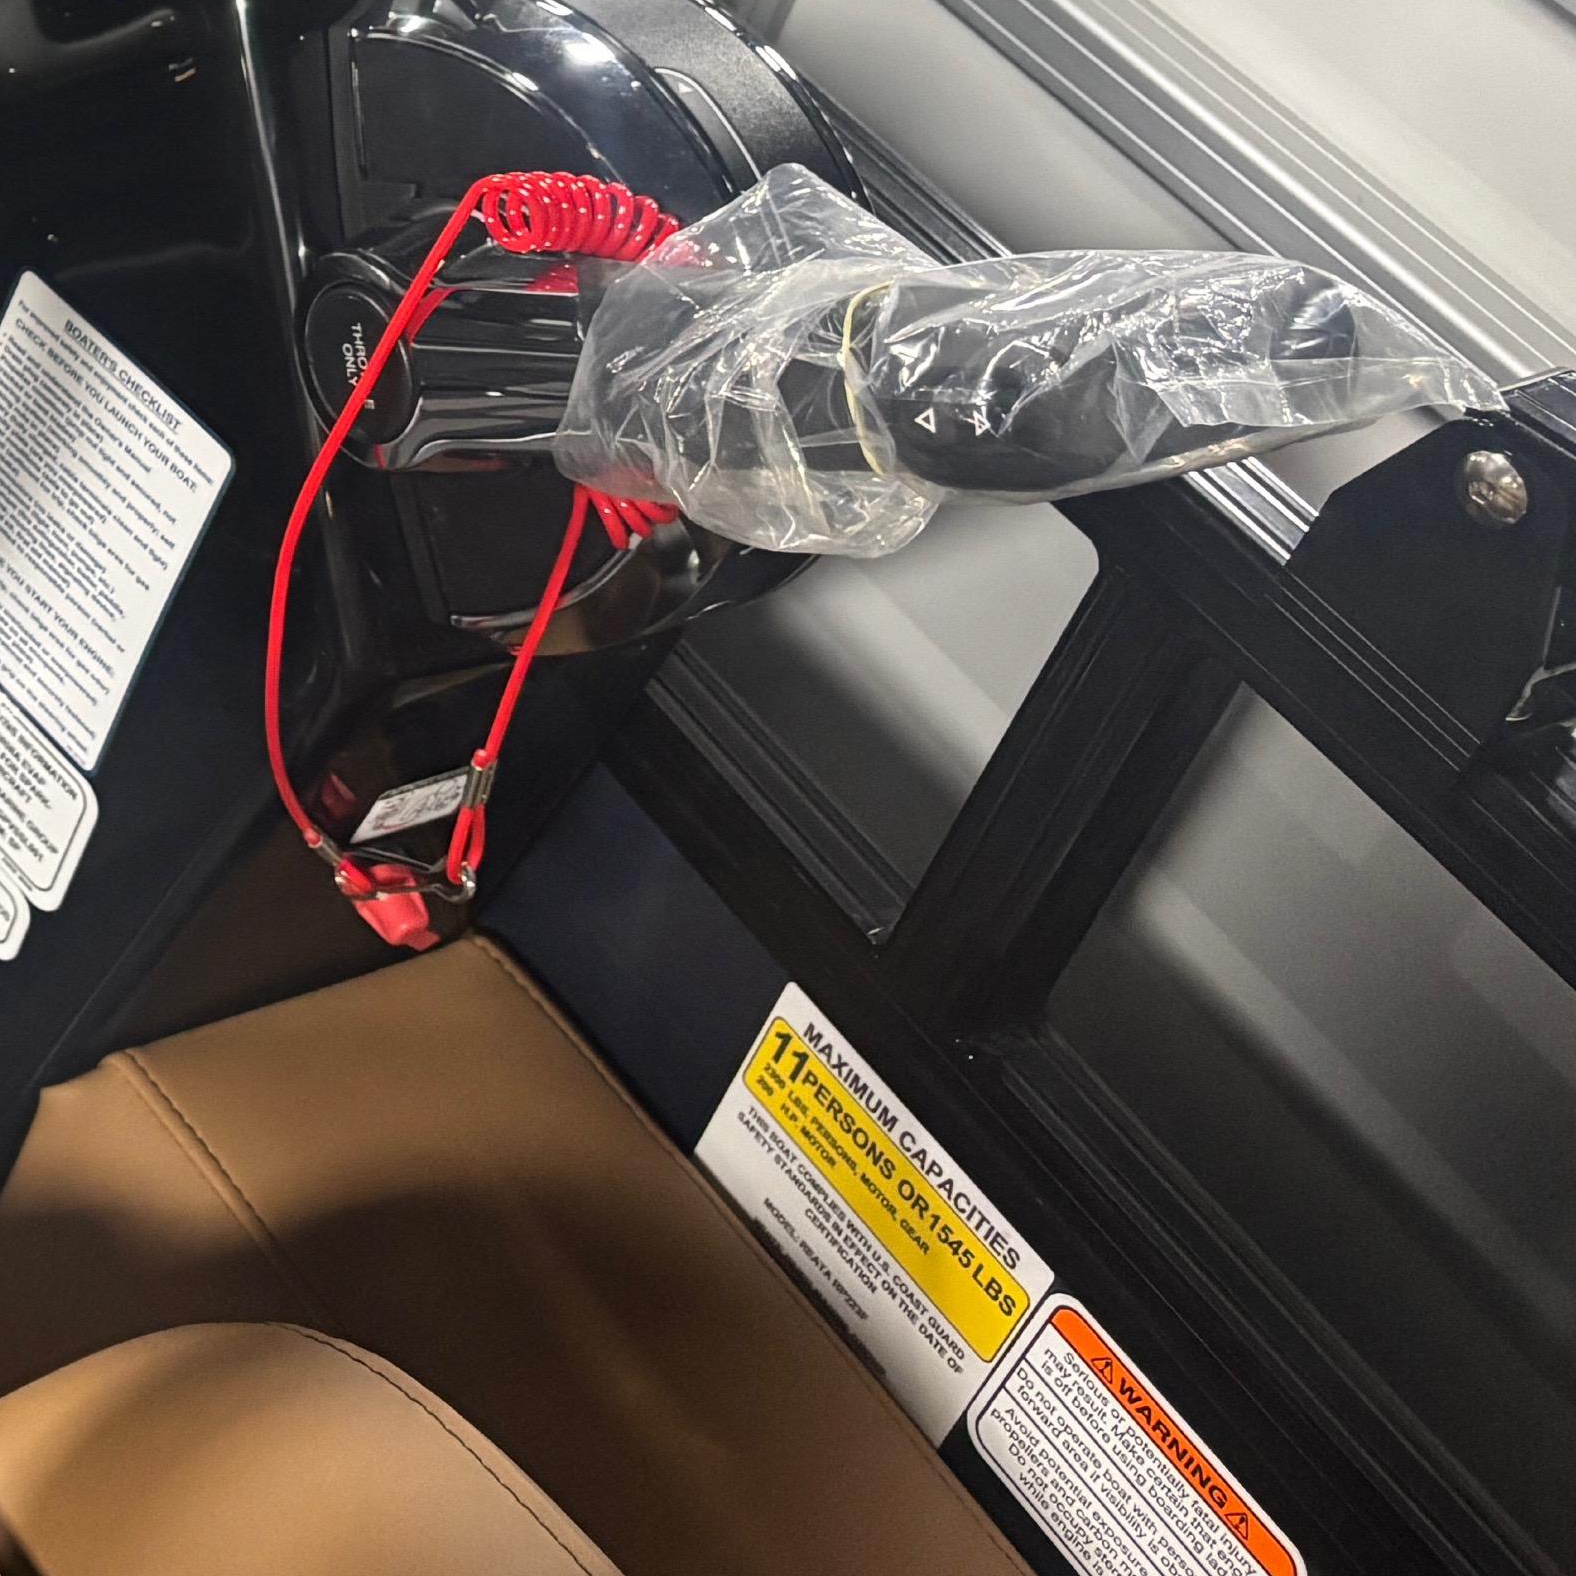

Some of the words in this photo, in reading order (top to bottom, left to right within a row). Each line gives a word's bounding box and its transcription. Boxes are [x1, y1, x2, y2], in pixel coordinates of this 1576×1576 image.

[15, 318, 47, 351] CHECK
[46, 347, 83, 384] BEFORE
[84, 380, 104, 404] YOU
[103, 399, 142, 440] LAUNCH
[143, 436, 169, 466] YOUR
[169, 462, 197, 492] BOAT:
[63, 318, 116, 372] BOATER'S
[115, 369, 181, 434] CHECKLIST
[342, 343, 360, 387] ONLY
[351, 322, 376, 410] THROE
[5, 563, 25, 586] YOU
[24, 583, 53, 613] START
[53, 611, 78, 640] YOUR
[772, 1031, 809, 1083] 11
[802, 1070, 895, 1179] PERSONS
[897, 1178, 929, 1220] OR
[928, 1213, 974, 1268] 1545
[971, 1263, 1016, 1316] LBS
[799, 1125, 836, 1168] MOTOR
[803, 1023, 897, 1131] MAXIMUM
[899, 1131, 1019, 1269] CAPACITIES
[737, 1111, 775, 1153] SAFETY
[774, 1153, 831, 1223] STANDARDS
[830, 1220, 843, 1237] IN
[842, 1234, 881, 1279] EFFECT
[880, 1279, 898, 1300] ON
[898, 1297, 919, 1325] THE
[918, 1322, 947, 1358] DATE
[946, 1356, 963, 1373] OF
[748, 1105, 769, 1133] THIS
[768, 1130, 797, 1163] BOAT
[797, 1163, 846, 1222] COMPLIES
[845, 1218, 872, 1252] WITH
[892, 1274, 928, 1315] COAST
[927, 1315, 964, 1360] GUARD
[804, 1208, 877, 1293] CERTIFICATION
[899, 1218, 930, 1255] GEAR
[990, 1408, 1049, 1477] propellers
[1049, 1477, 1076, 1507] and
[1075, 1508, 1118, 1560] carbon
[1004, 1407, 1040, 1447] Avoid
[1038, 1448, 1092, 1509] potential
[1091, 1510, 1148, 1576] exposure
[1007, 1442, 1026, 1466] Do
[1026, 1467, 1049, 1492] not
[1048, 1492, 1093, 1545] occupy
[1016, 1366, 1034, 1390] Do
[1034, 1390, 1056, 1416] not
[1056, 1415, 1102, 1469] operate
[1102, 1468, 1132, 1504] boat
[1132, 1503, 1157, 1535] with
[1016, 1384, 1063, 1438] forward
[1061, 1439, 1088, 1472] area
[1088, 1469, 1101, 1483] if
[1100, 1483, 1147, 1538] visibility
[1147, 1537, 1159, 1555] is
[1159, 1555, 1181, 1576] ob
[1040, 1359, 1053, 1376] is
[1053, 1375, 1073, 1396] off
[1071, 1395, 1110, 1443] before
[1111, 1443, 1147, 1487] using
[1147, 1484, 1204, 1554] boarding
[1043, 1348, 1072, 1378] may
[1071, 1379, 1107, 1424] result.
[1110, 1423, 1145, 1465] Make
[1145, 1467, 1189, 1517] certain
[1189, 1516, 1217, 1549] that
[1063, 1351, 1109, 1406] Serious
[1110, 1407, 1126, 1424] or
[1122, 1425, 1189, 1501] potentially
[1190, 1499, 1220, 1533] fatal
[1219, 1532, 1256, 1576] injury
[1114, 1376, 1230, 1508] WARNING
[1018, 1471, 1049, 1510] while
[1050, 1511, 1091, 1560] engine
[1091, 1559, 1104, 1576] is
